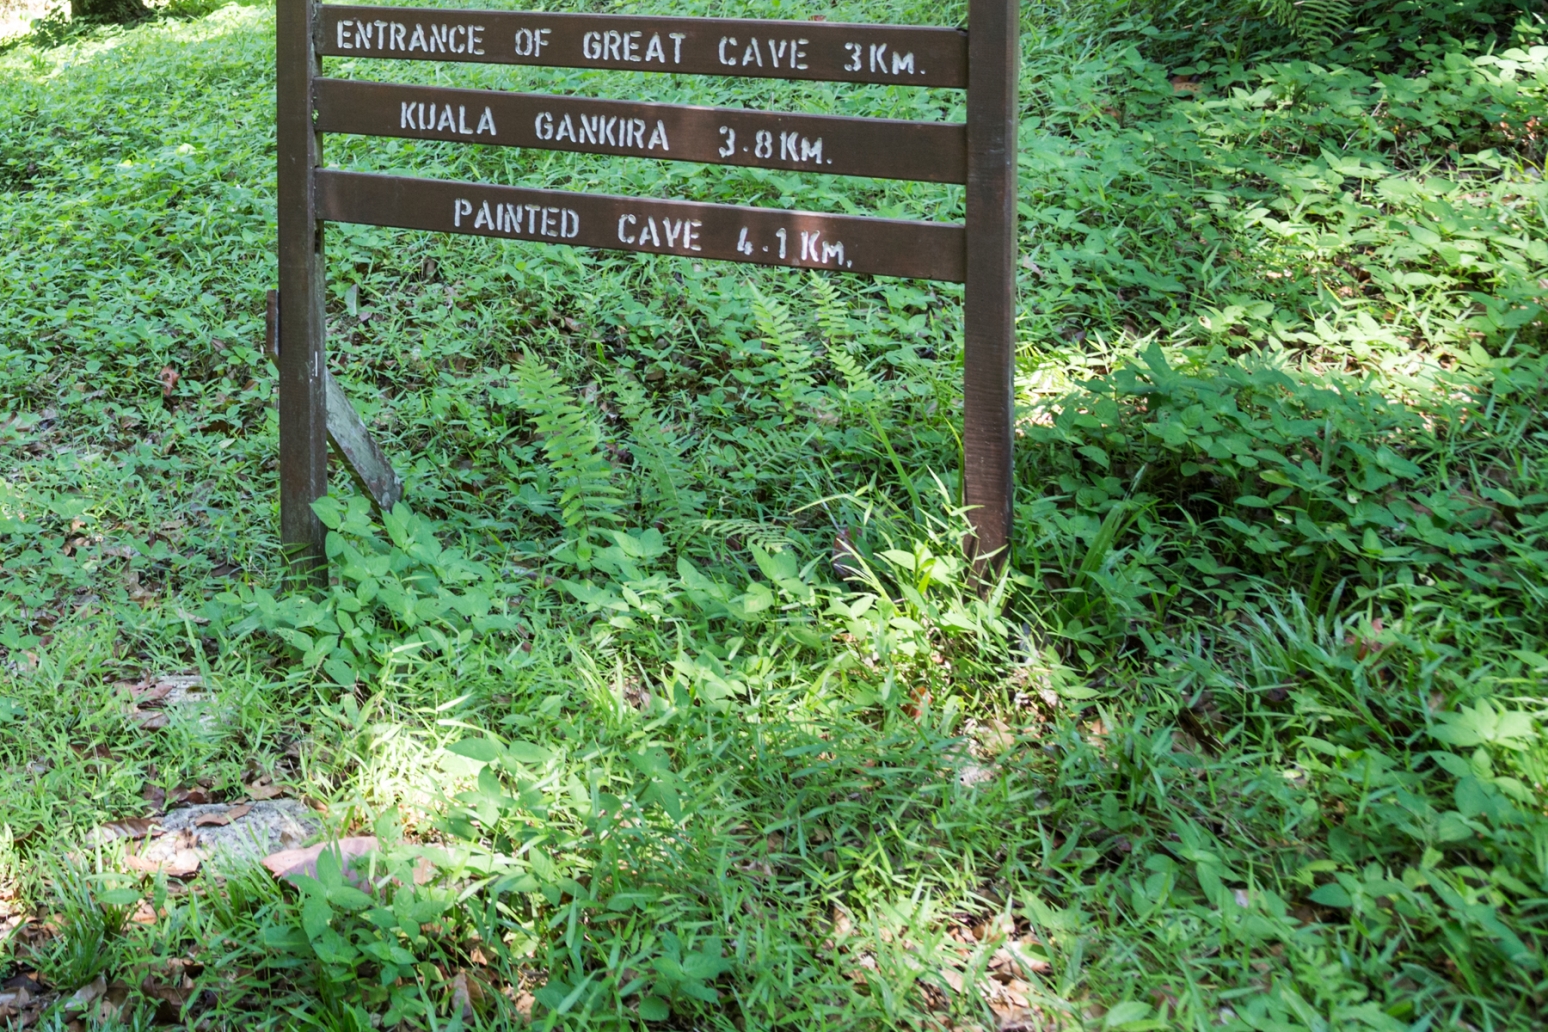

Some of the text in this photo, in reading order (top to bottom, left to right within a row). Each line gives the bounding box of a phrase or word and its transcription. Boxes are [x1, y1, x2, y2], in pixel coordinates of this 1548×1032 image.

[337, 20, 485, 55] ENTRANCE
[515, 28, 552, 57] OF
[583, 31, 686, 64] GREAT
[718, 36, 809, 70] CAVE
[400, 101, 497, 136] KUALA
[534, 112, 670, 151] GANKIRA
[454, 198, 580, 238] PAINTED
[617, 213, 702, 251] CAVE
